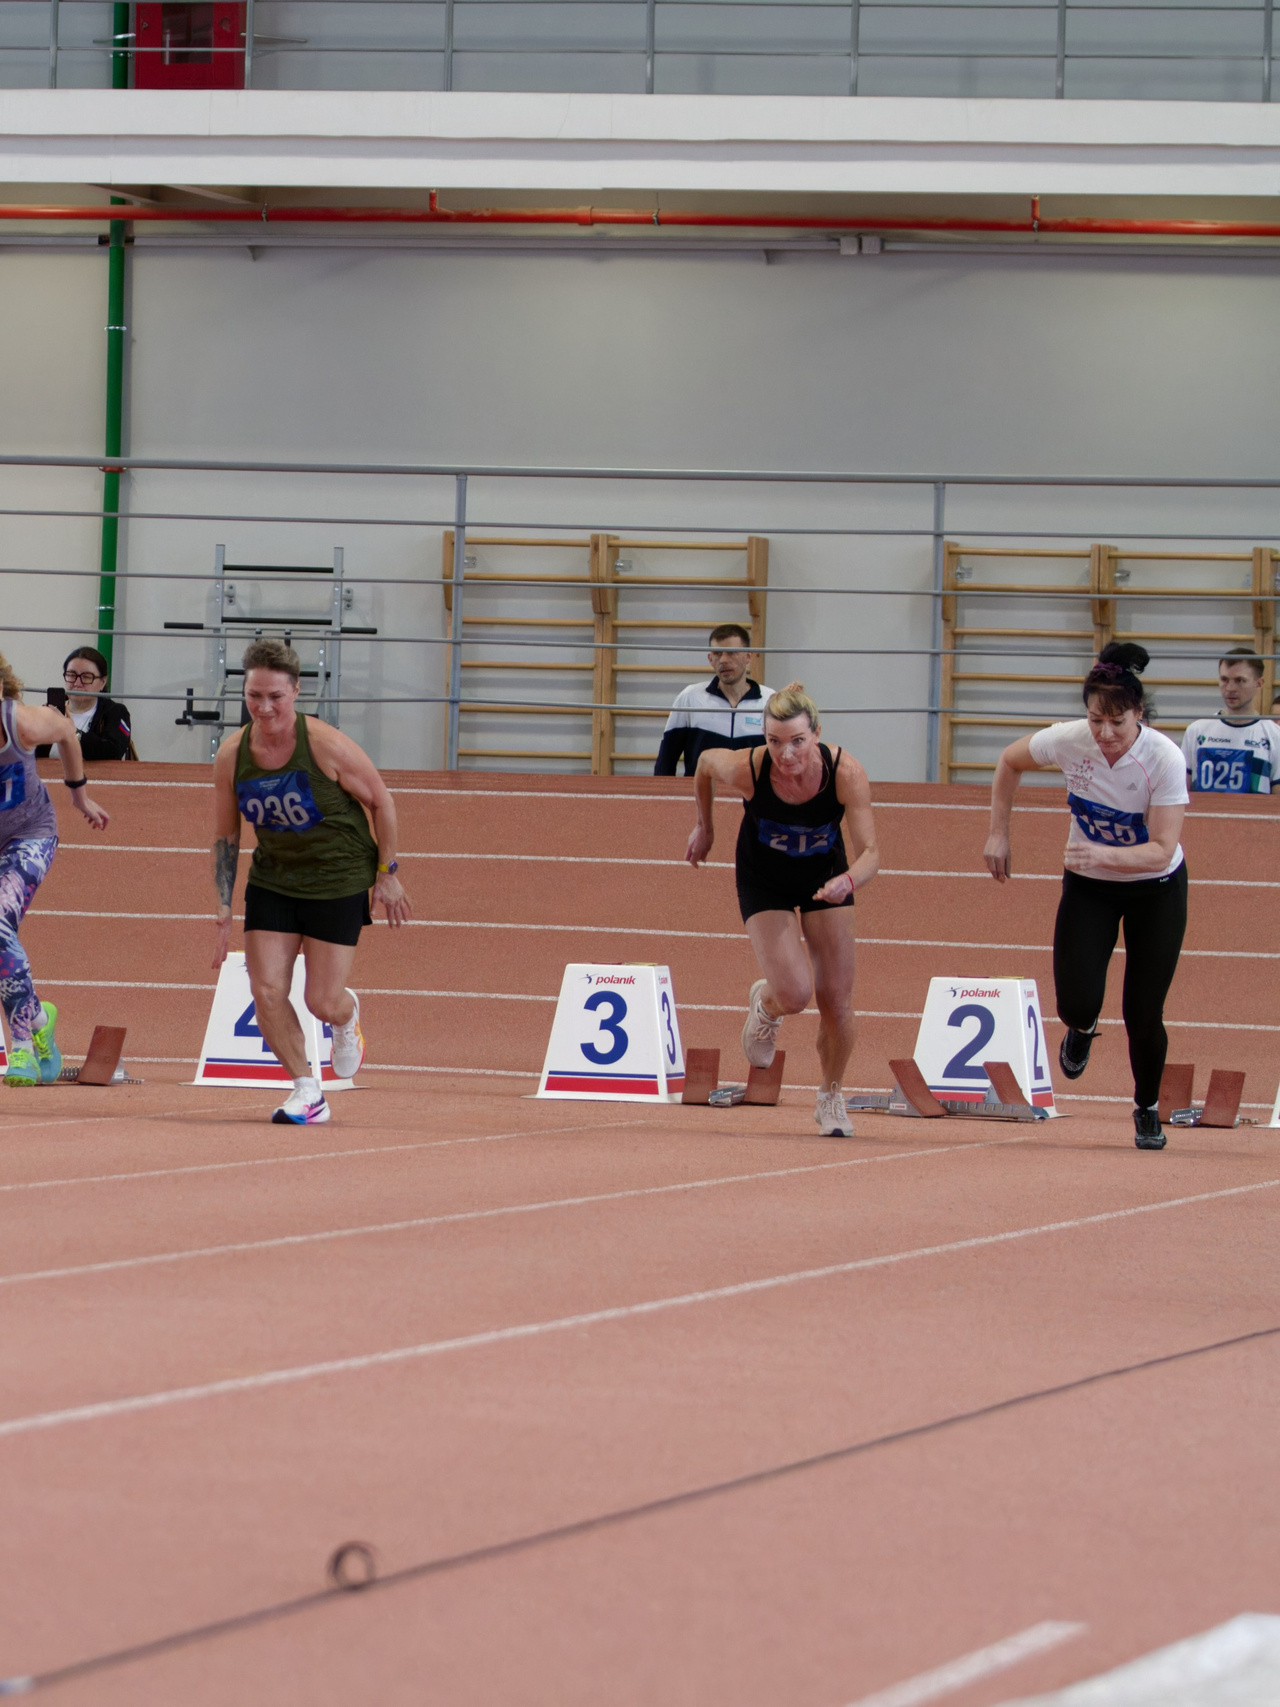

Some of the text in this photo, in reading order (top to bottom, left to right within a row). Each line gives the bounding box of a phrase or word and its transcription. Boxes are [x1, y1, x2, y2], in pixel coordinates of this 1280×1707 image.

[1201, 760, 1245, 790] 025
[246, 791, 310, 826] 236
[595, 975, 636, 985] polanik
[960, 987, 1001, 998] polanik
[580, 990, 629, 1065] 3
[661, 991, 676, 1066] 3
[942, 1004, 995, 1080] 2
[1027, 1004, 1044, 1080] 2
